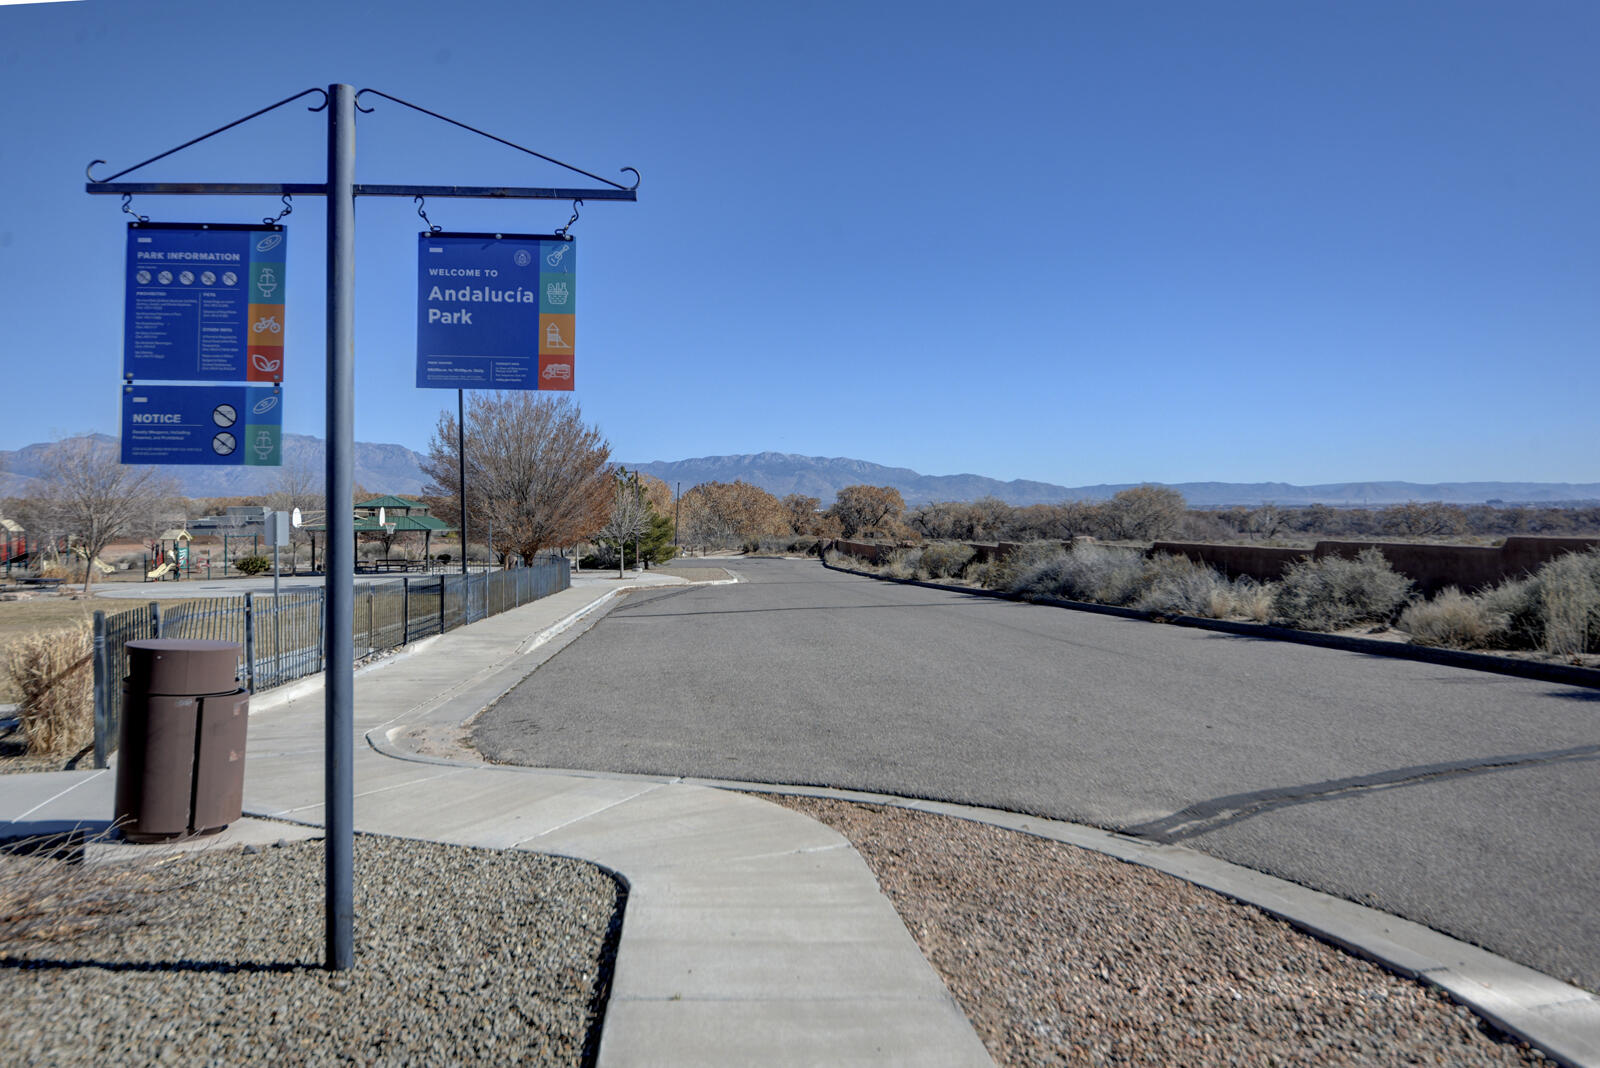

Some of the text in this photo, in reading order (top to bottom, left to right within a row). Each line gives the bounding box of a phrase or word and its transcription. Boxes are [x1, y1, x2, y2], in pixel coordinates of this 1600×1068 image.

[168, 252, 240, 261] INFORMATION
[429, 268, 480, 276] WELCOME
[428, 286, 534, 303] Andalucía
[428, 309, 472, 324] Park
[132, 414, 182, 423] NOTICE
